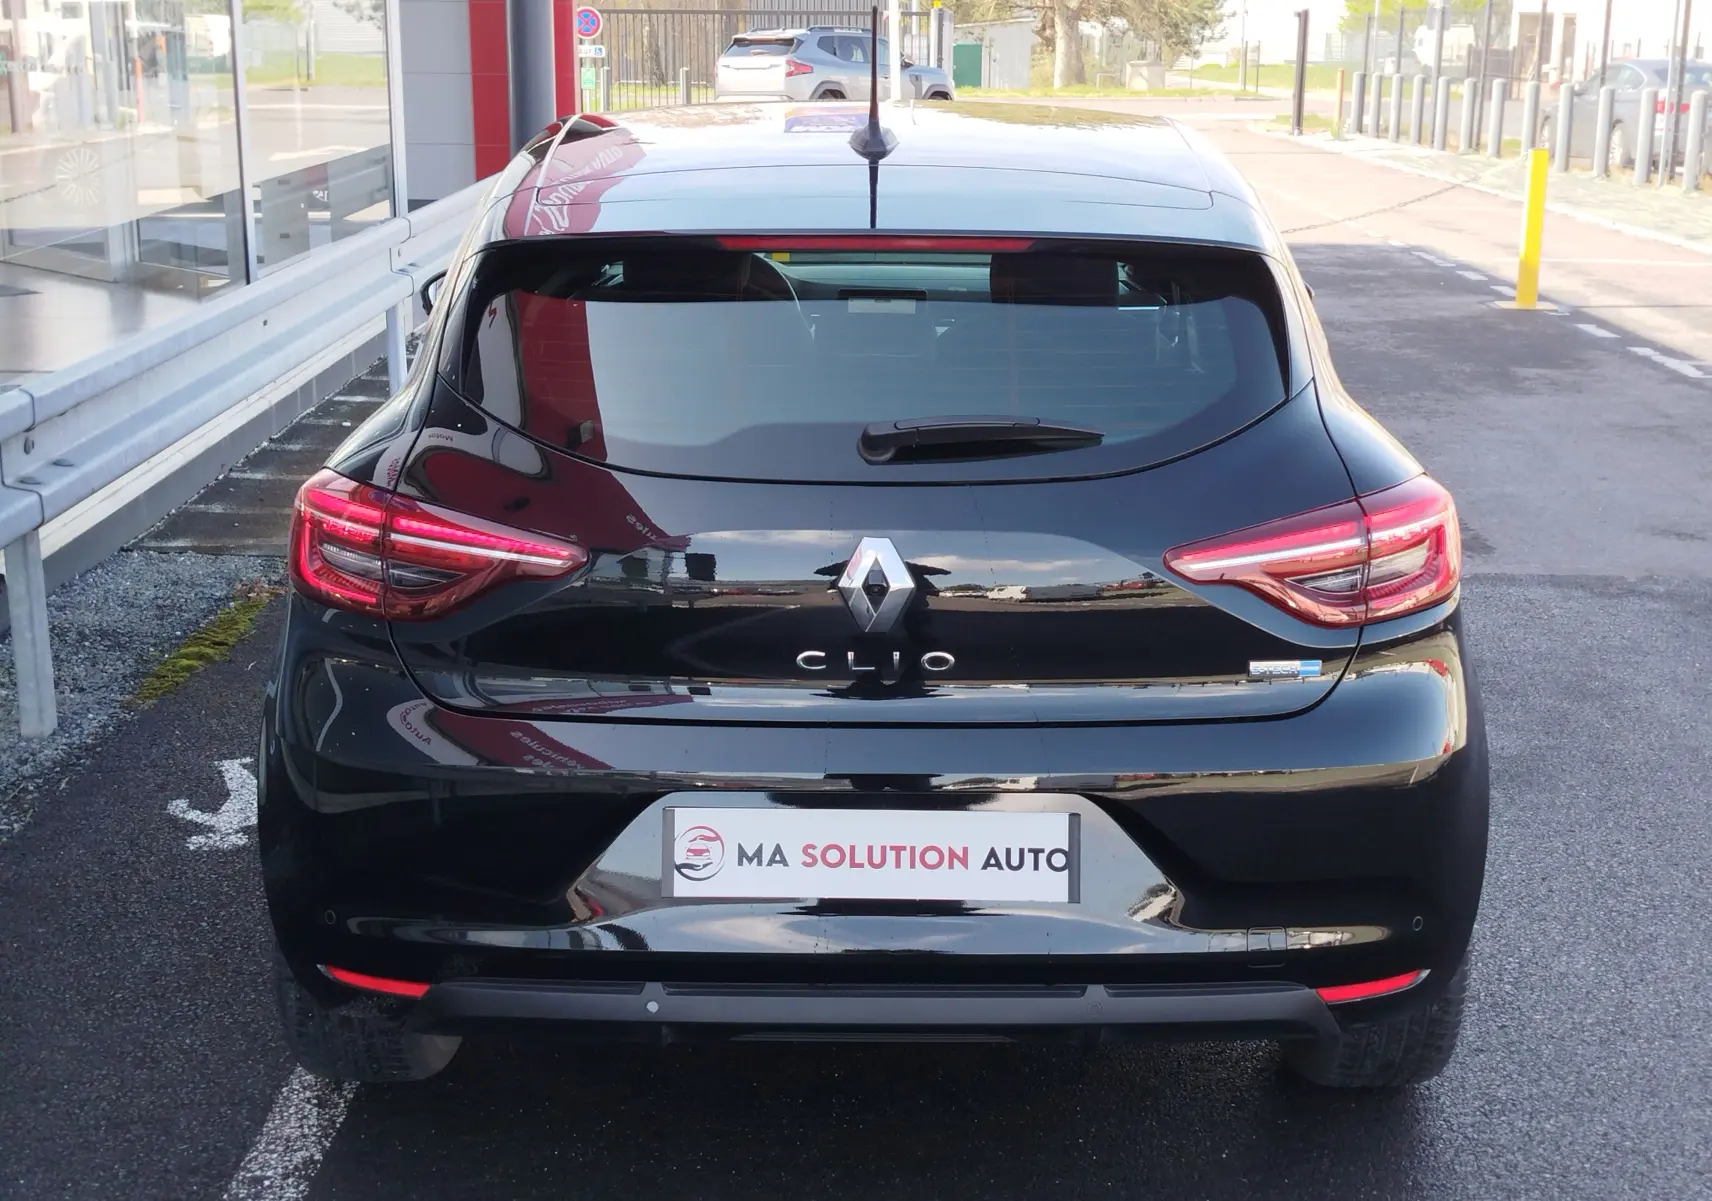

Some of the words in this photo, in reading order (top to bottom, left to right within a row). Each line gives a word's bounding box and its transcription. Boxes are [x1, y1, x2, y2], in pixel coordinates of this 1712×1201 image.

[796, 650, 955, 671] CLIO
[737, 842, 789, 868] MA
[801, 843, 969, 870] SOLUTION
[981, 846, 1069, 872] AUTO
